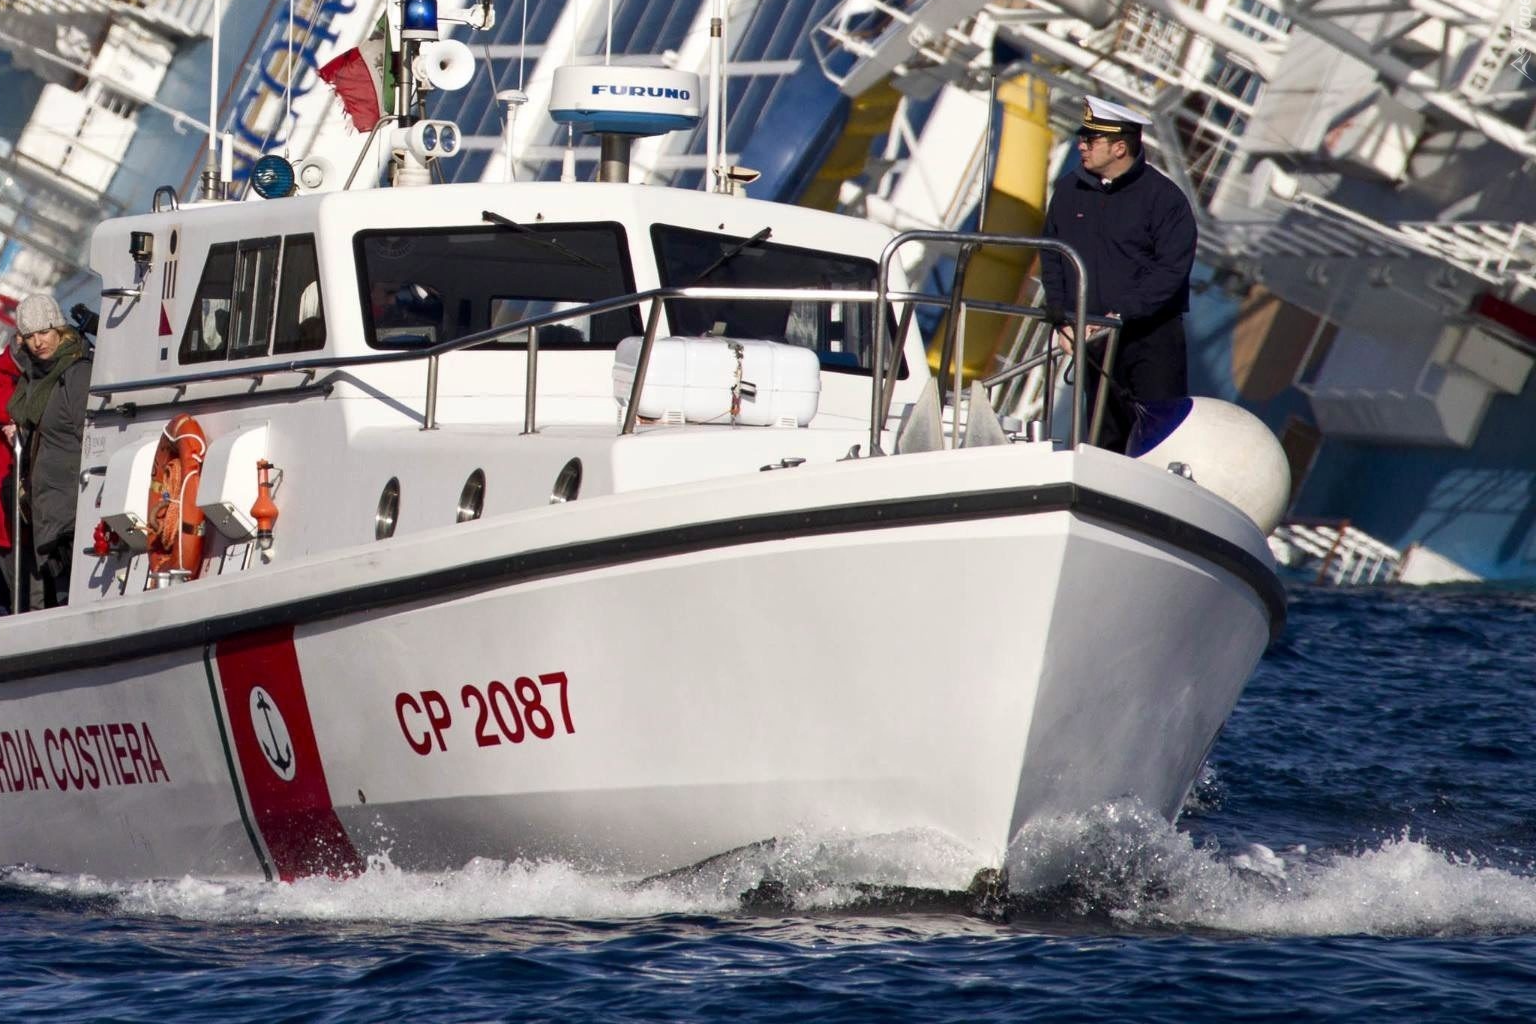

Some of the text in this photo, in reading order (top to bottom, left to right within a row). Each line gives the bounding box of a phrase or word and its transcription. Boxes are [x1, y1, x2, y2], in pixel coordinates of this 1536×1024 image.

[591, 85, 691, 100] FURUNO
[395, 671, 576, 756] CP 2087
[43, 721, 171, 792] COSTIERA
